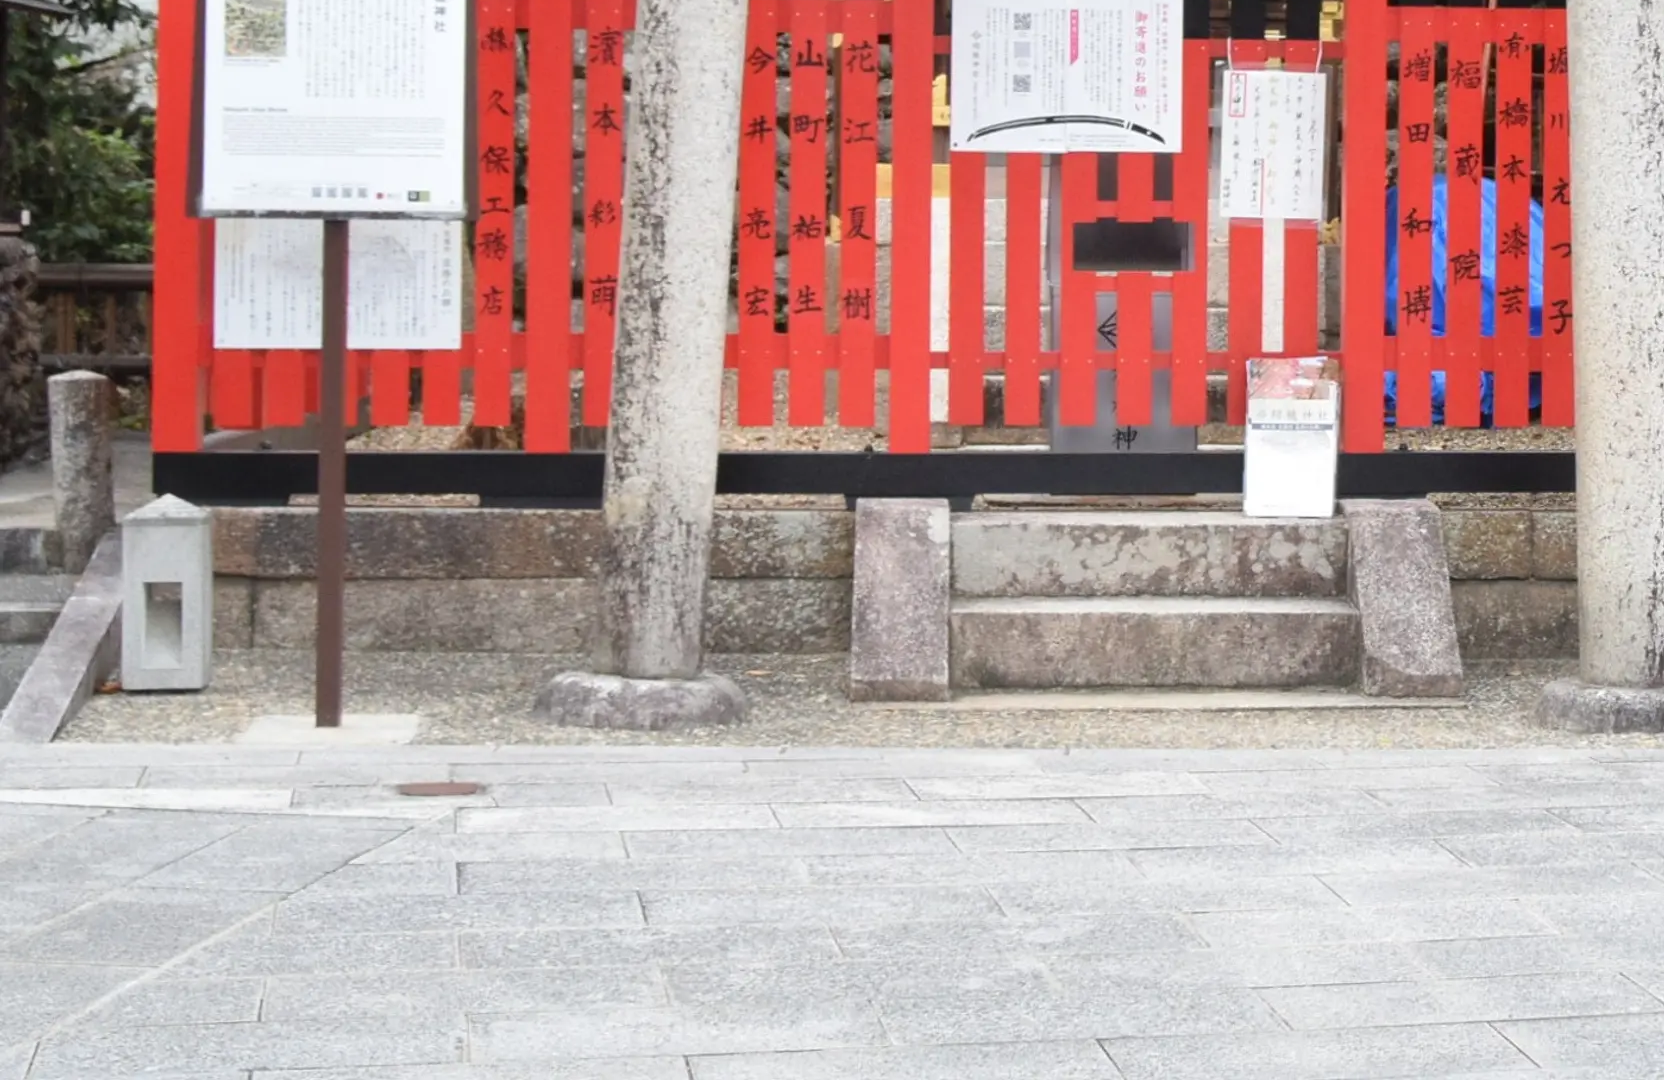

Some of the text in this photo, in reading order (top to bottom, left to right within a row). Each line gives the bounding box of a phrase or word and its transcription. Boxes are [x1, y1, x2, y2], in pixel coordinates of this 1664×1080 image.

[742, 45, 775, 318] 今井亮宏
[843, 40, 875, 320] 花江夏樹
